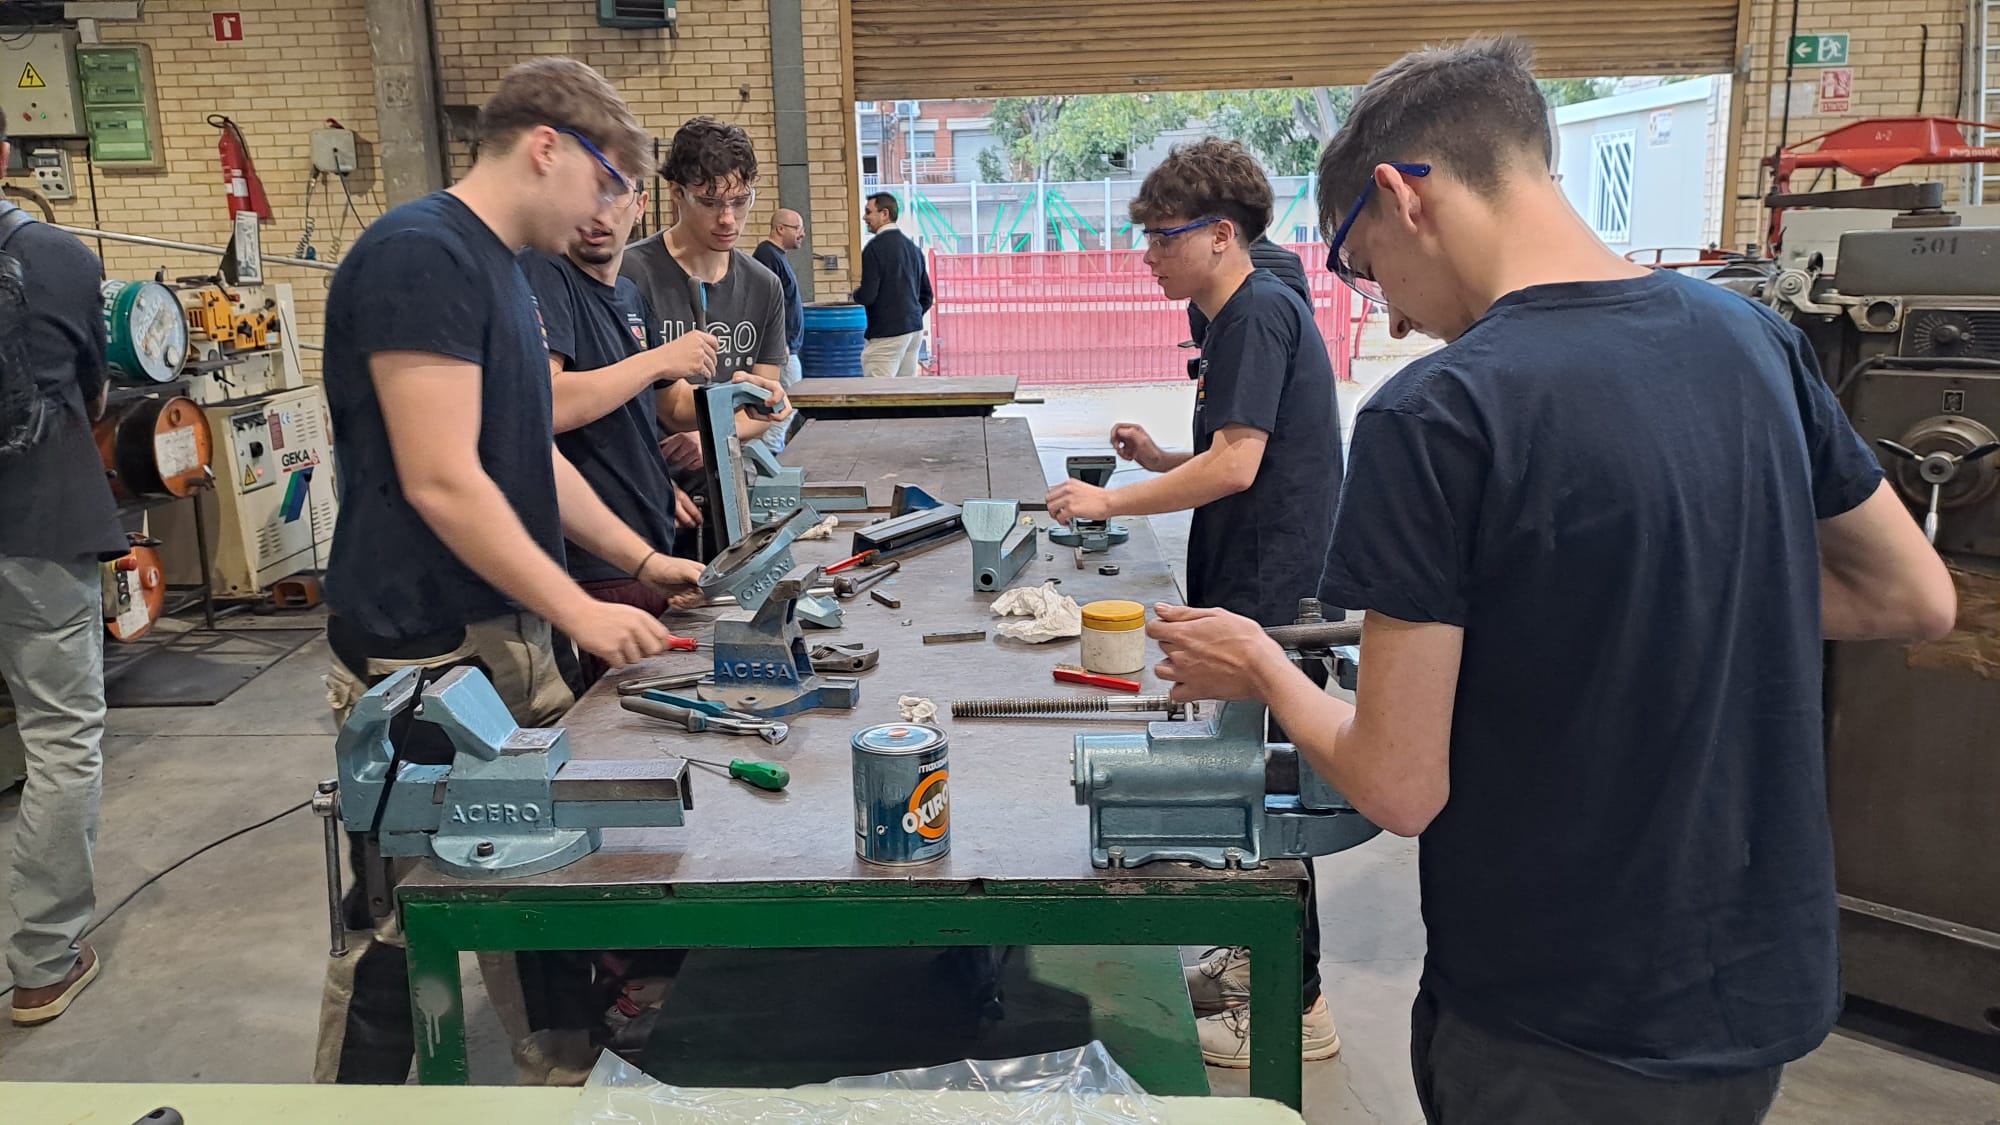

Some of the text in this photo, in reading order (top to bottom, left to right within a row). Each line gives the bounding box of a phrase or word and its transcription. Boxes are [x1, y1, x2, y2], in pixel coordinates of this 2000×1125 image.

[281, 449, 310, 467] GEKA
[755, 496, 796, 508] ACERO
[720, 662, 793, 680] ACESA
[451, 802, 540, 824] ACERO
